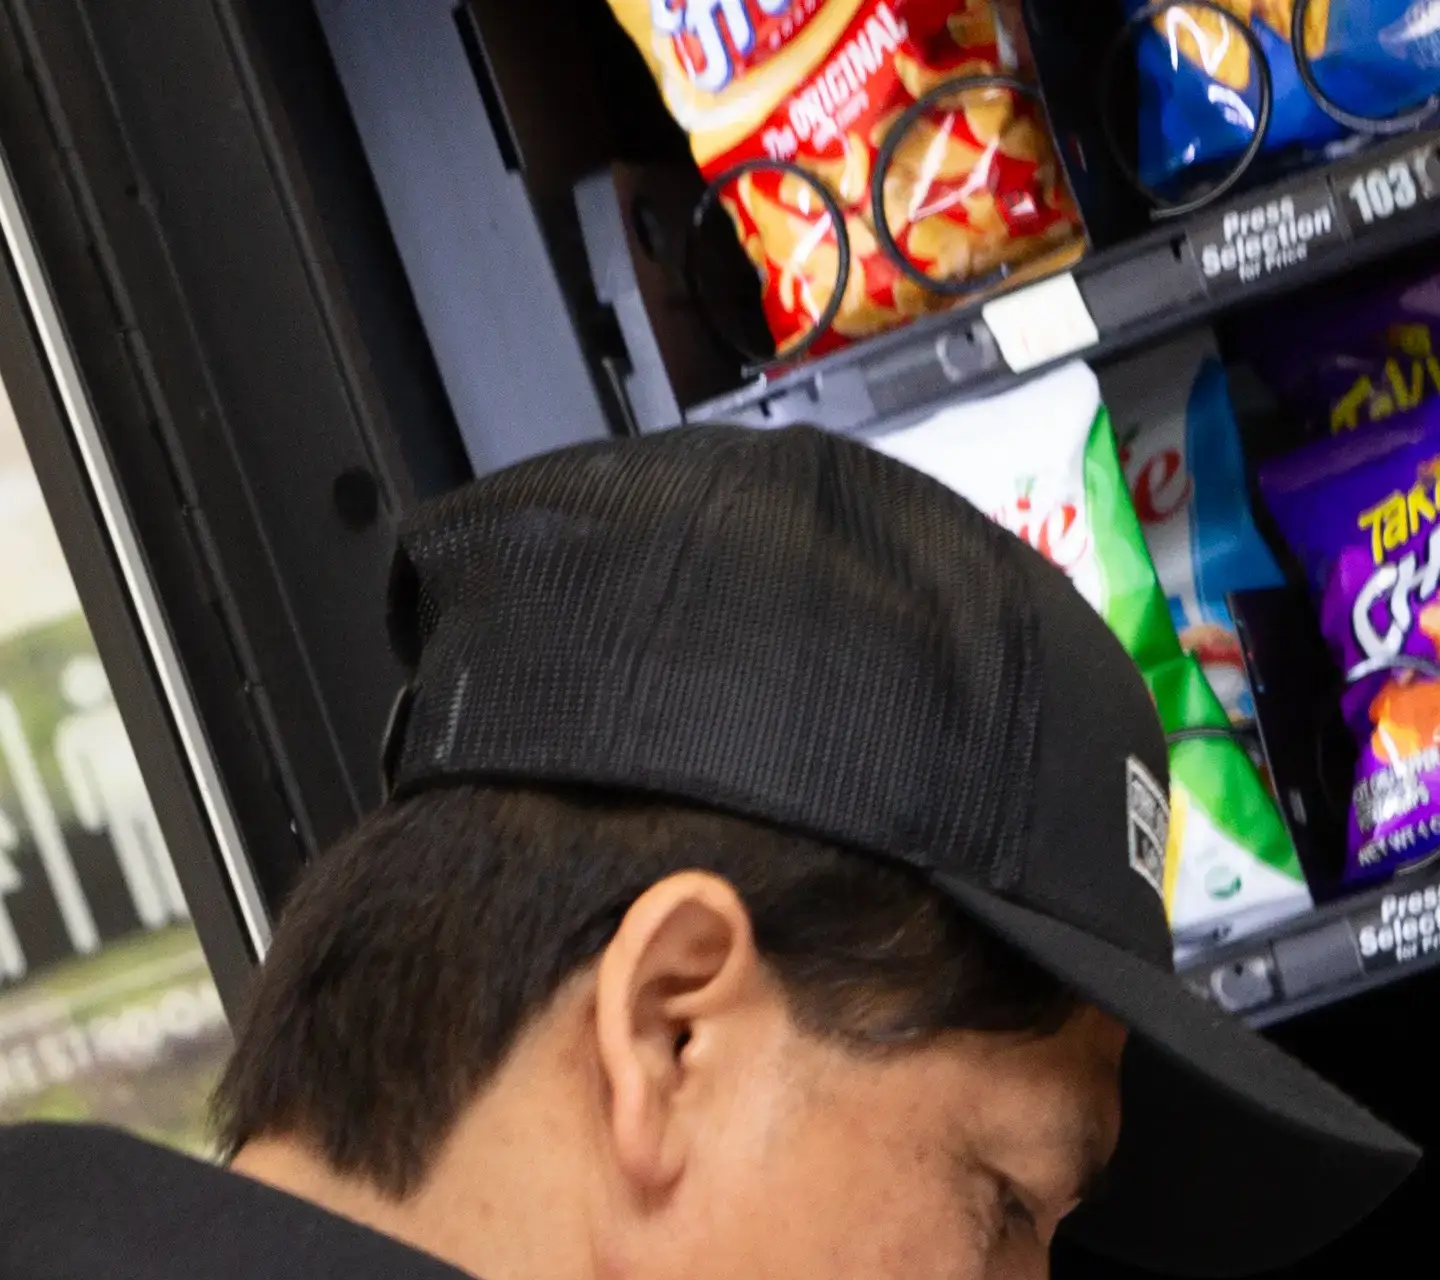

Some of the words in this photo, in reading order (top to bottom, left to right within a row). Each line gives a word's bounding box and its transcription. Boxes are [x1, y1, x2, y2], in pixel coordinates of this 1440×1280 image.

[789, 2, 908, 142] ORIGINAL
[1222, 197, 1294, 241] Press
[1349, 163, 1417, 222] 103
[1202, 205, 1331, 276] Selection
[1264, 243, 1308, 274] Price
